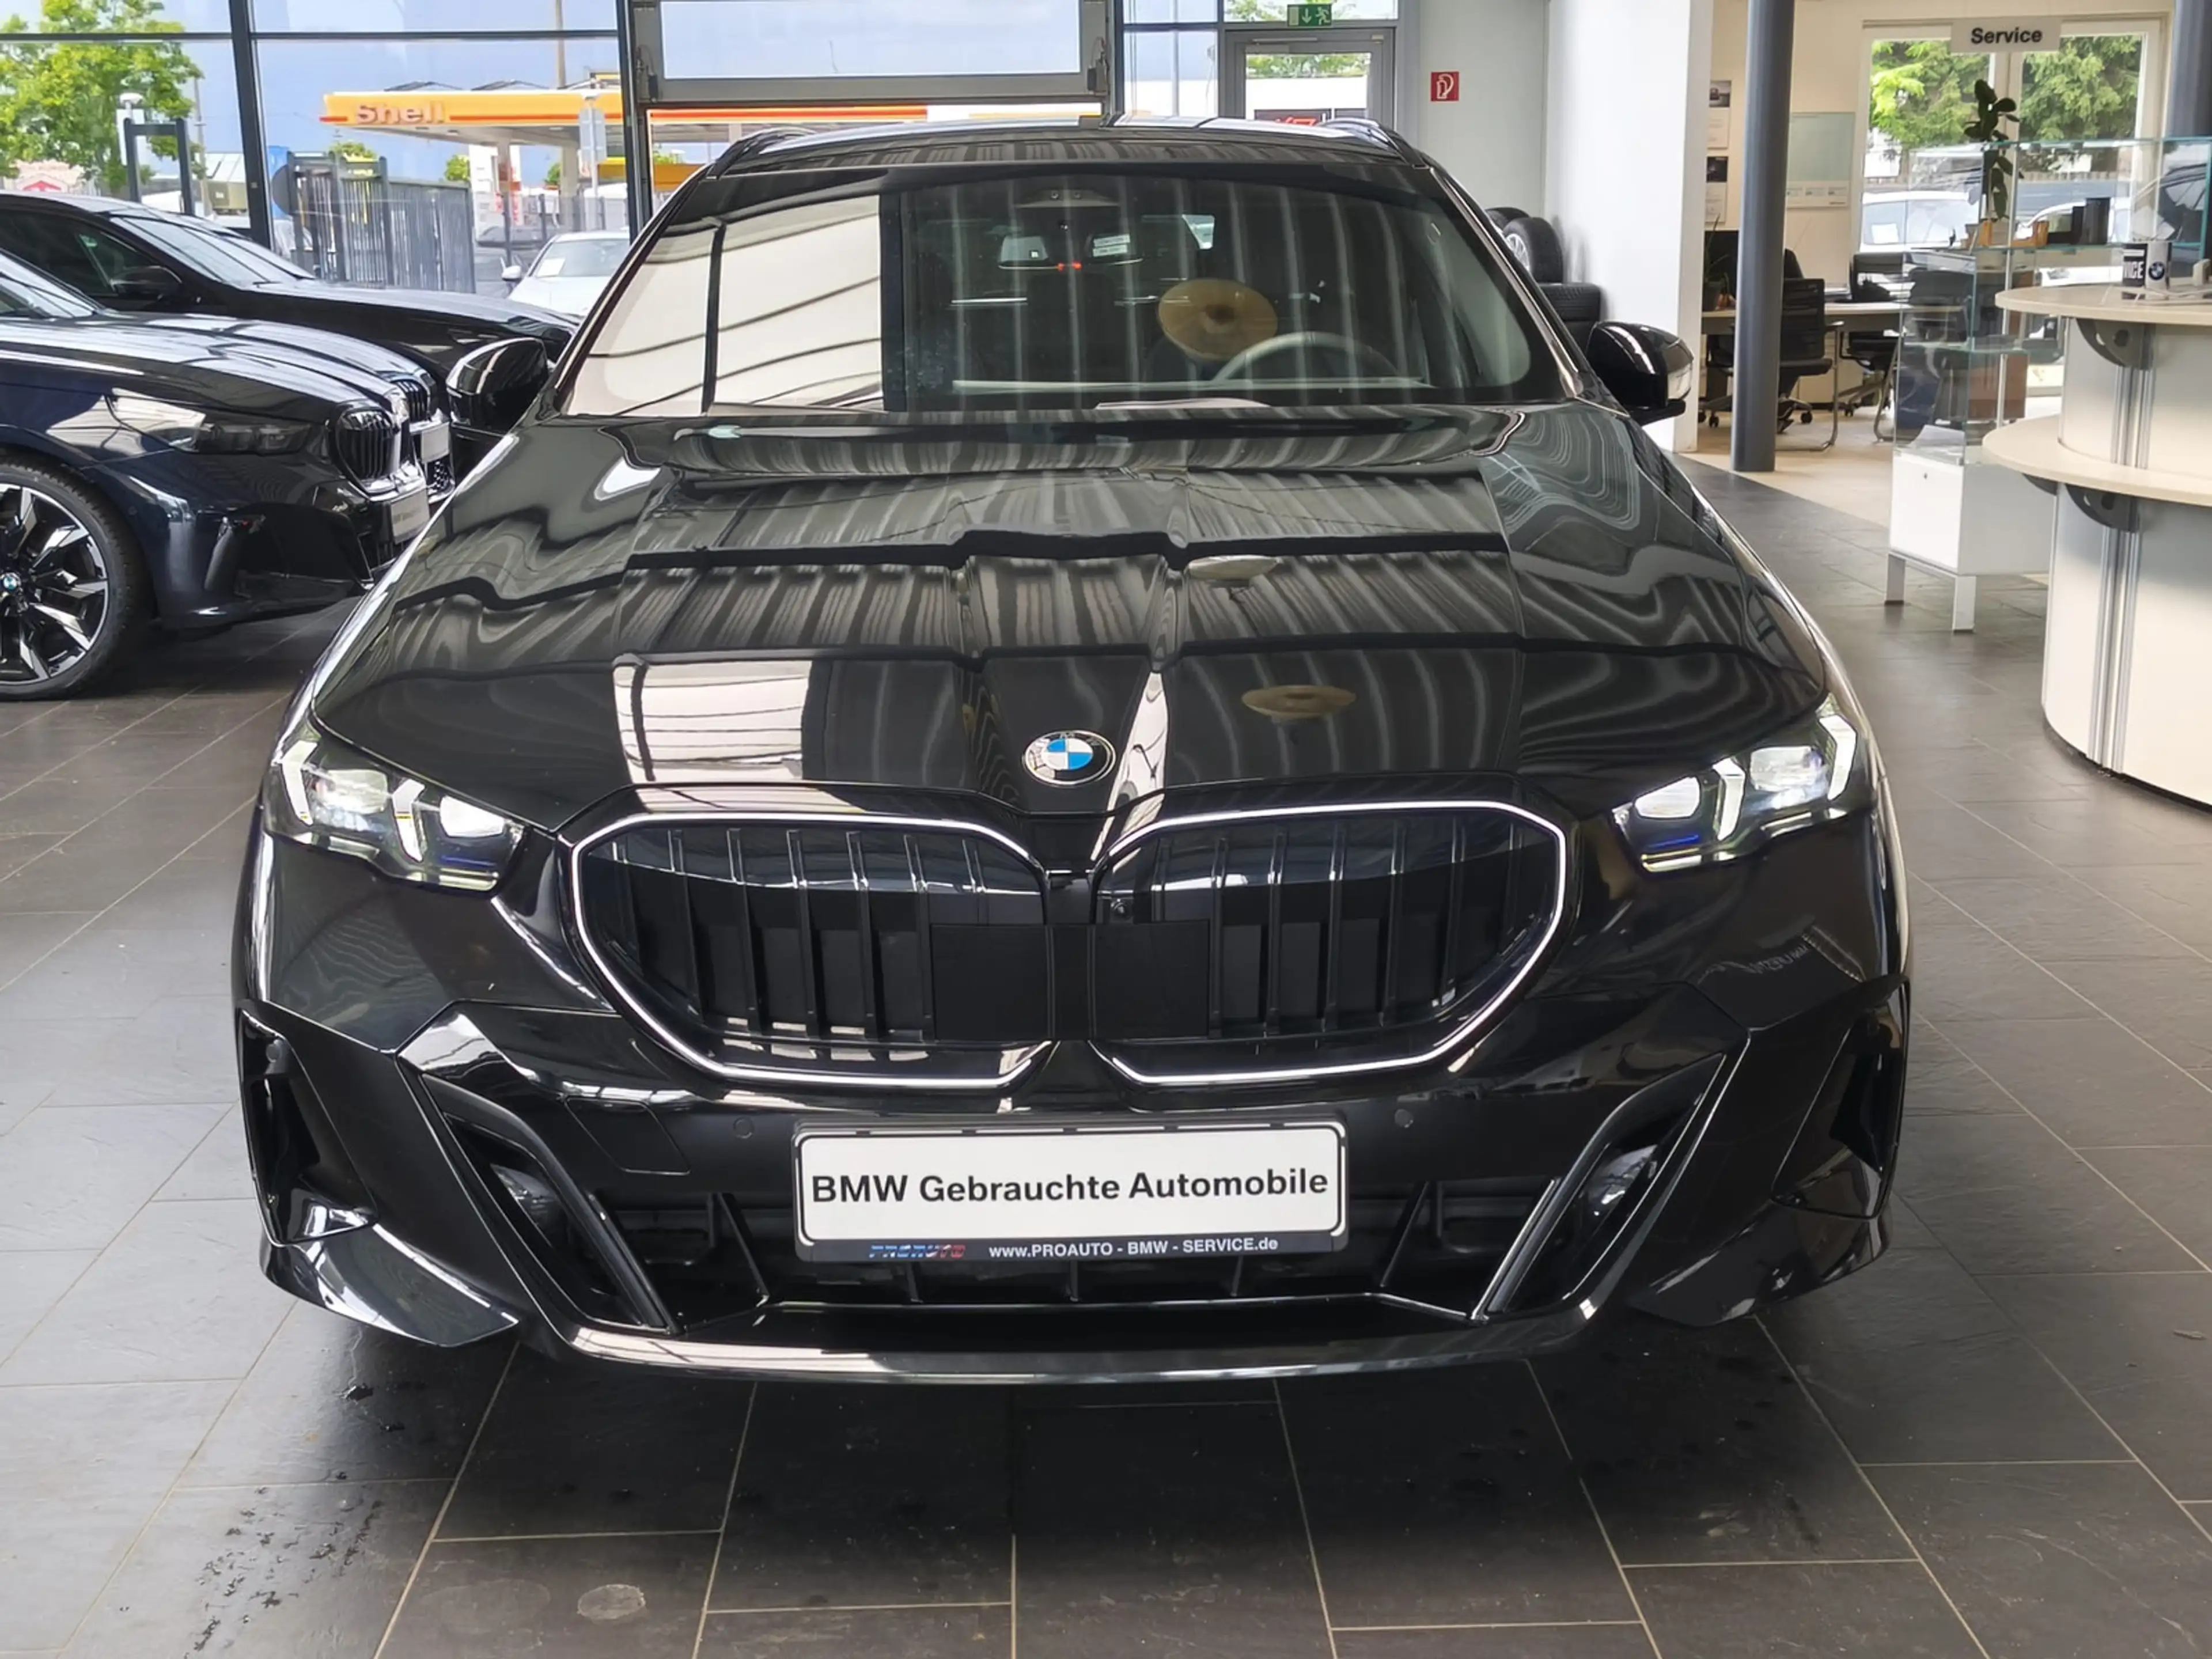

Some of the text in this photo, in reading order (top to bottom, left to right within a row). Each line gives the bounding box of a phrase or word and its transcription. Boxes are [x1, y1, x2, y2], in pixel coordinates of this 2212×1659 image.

[1971, 26, 2043, 44] Service
[357, 102, 444, 124] Shell
[812, 1168, 1328, 1202] BMW Gebrauchte Automobile
[988, 1242, 1113, 1257] www.PROAUTO
[1127, 1240, 1169, 1255] BMW
[1183, 1237, 1278, 1253] SERVICE.de
